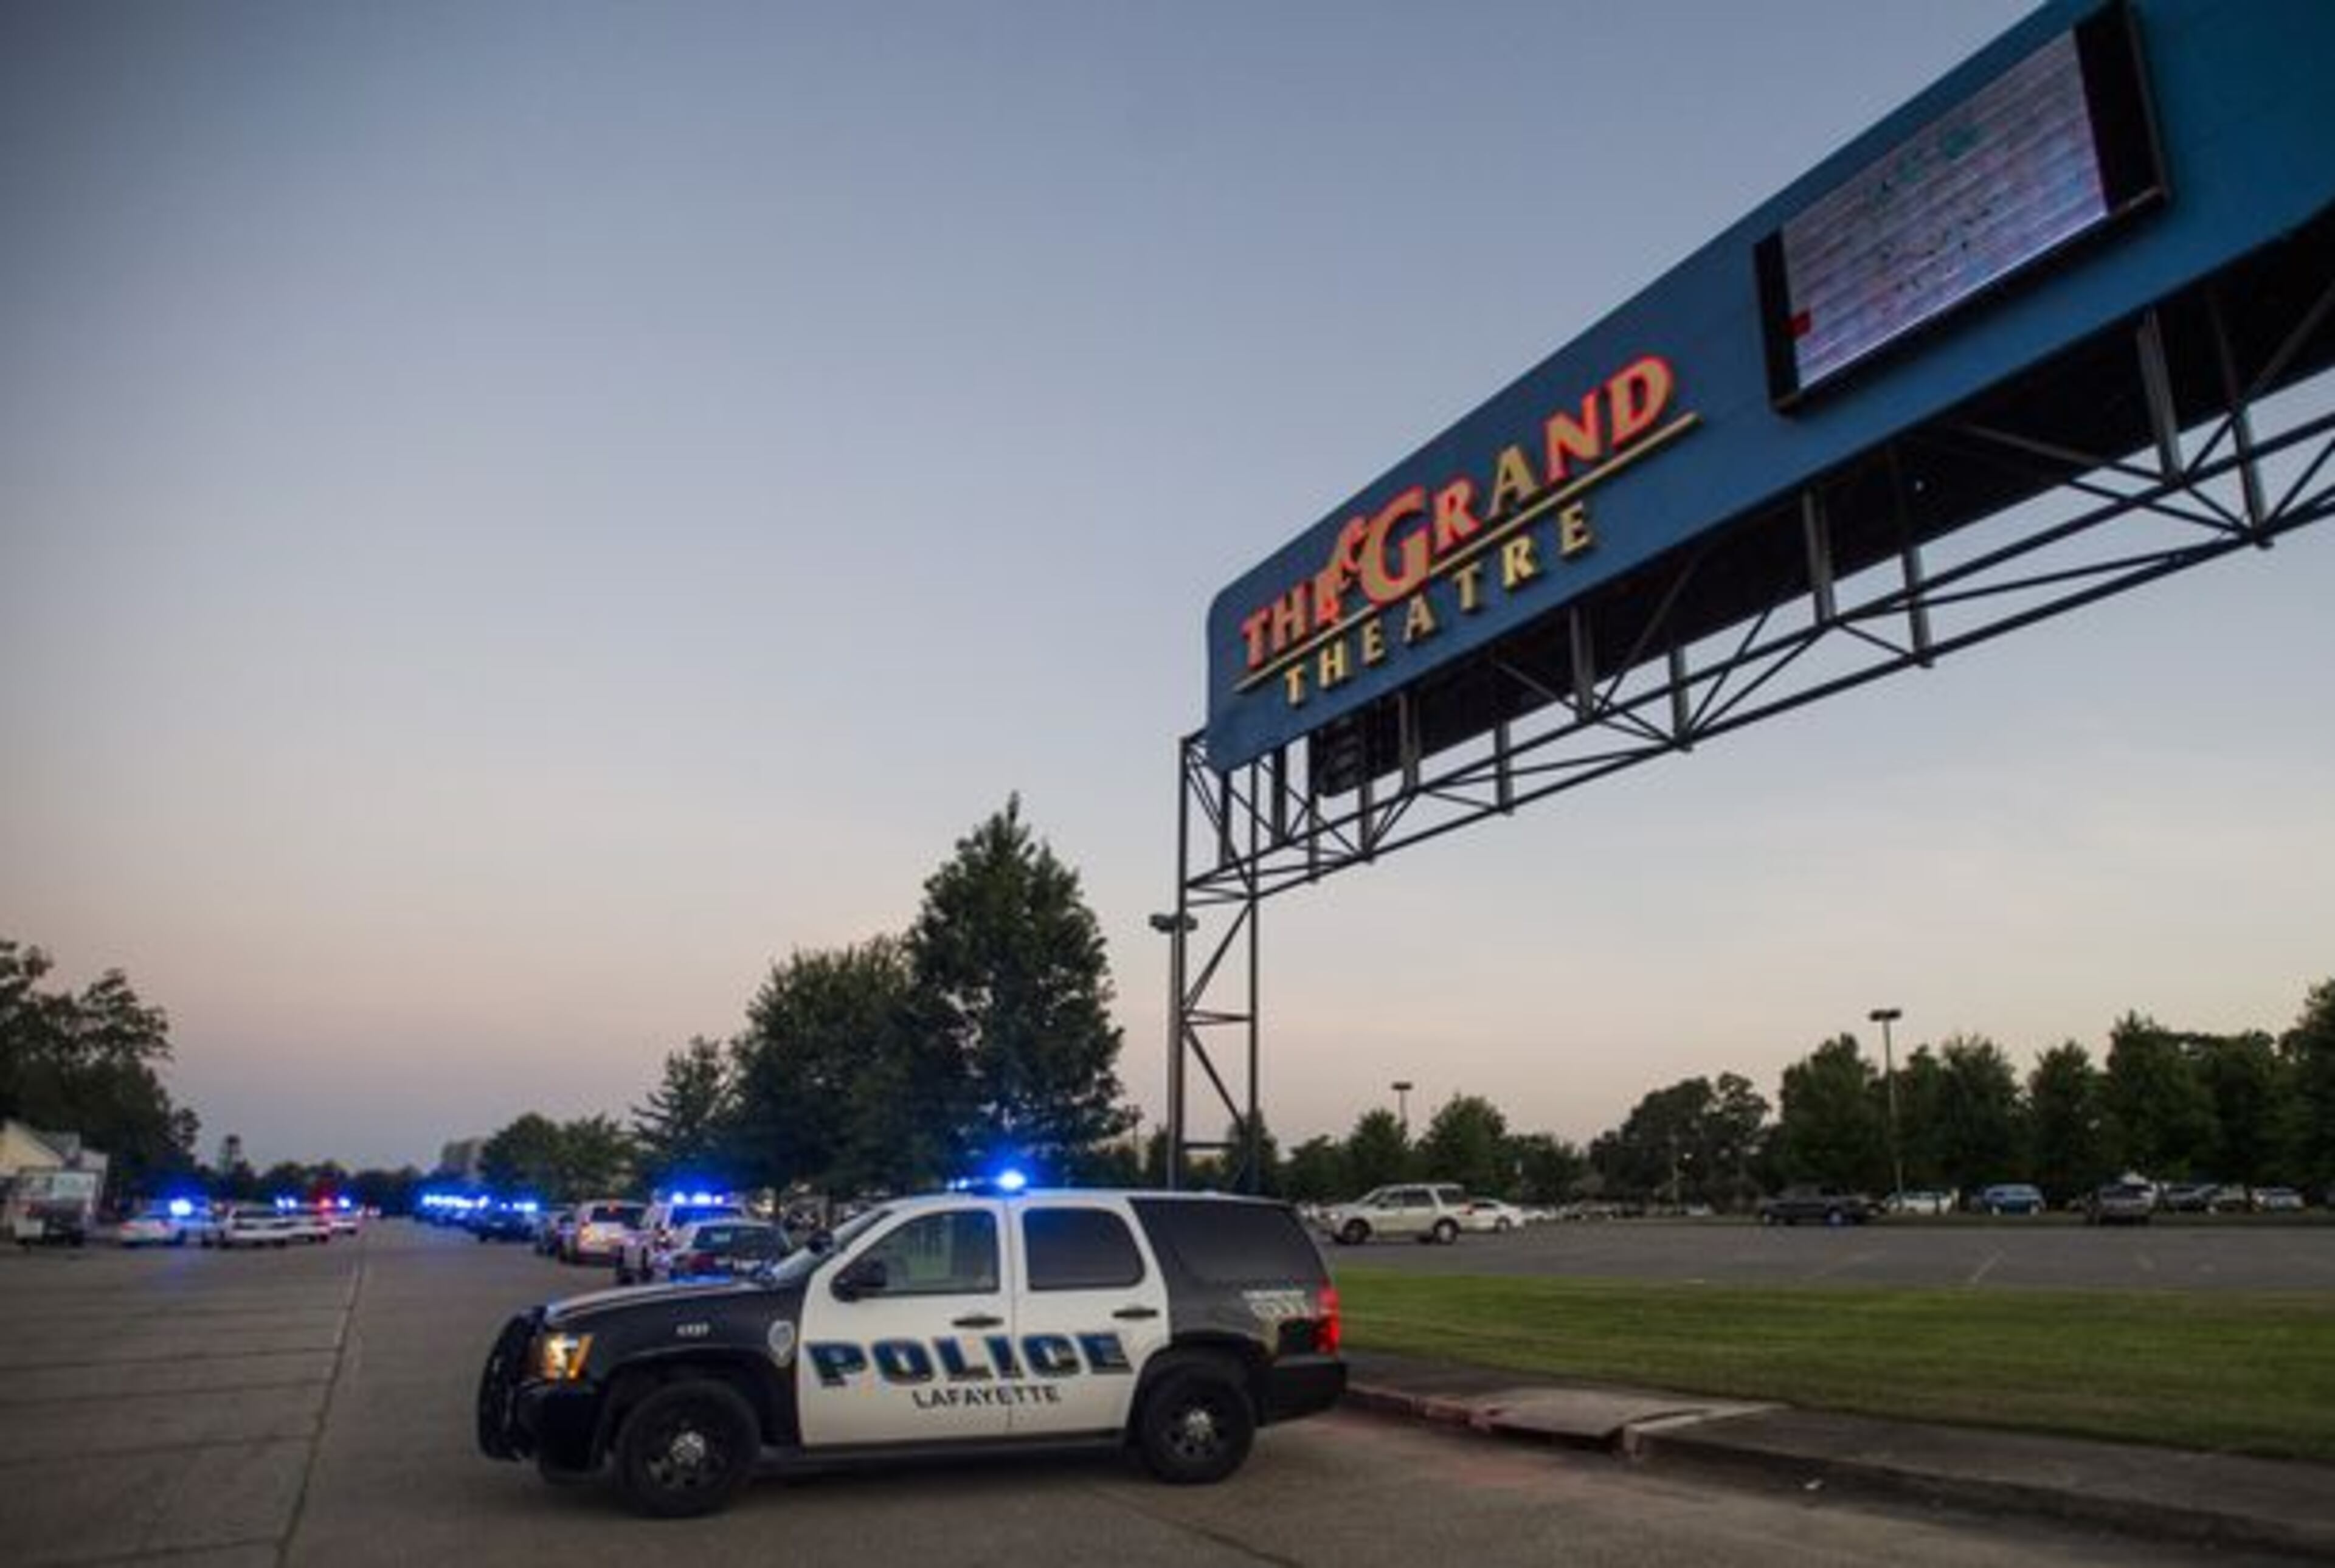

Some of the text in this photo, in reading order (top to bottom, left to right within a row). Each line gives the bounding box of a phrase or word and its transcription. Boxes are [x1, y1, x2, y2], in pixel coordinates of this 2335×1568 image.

[1241, 569, 1341, 669] THE
[1284, 503, 1591, 705] THEATRE
[804, 1333, 1133, 1387] POLICE
[913, 1384, 1062, 1410] LAFAYETTE
